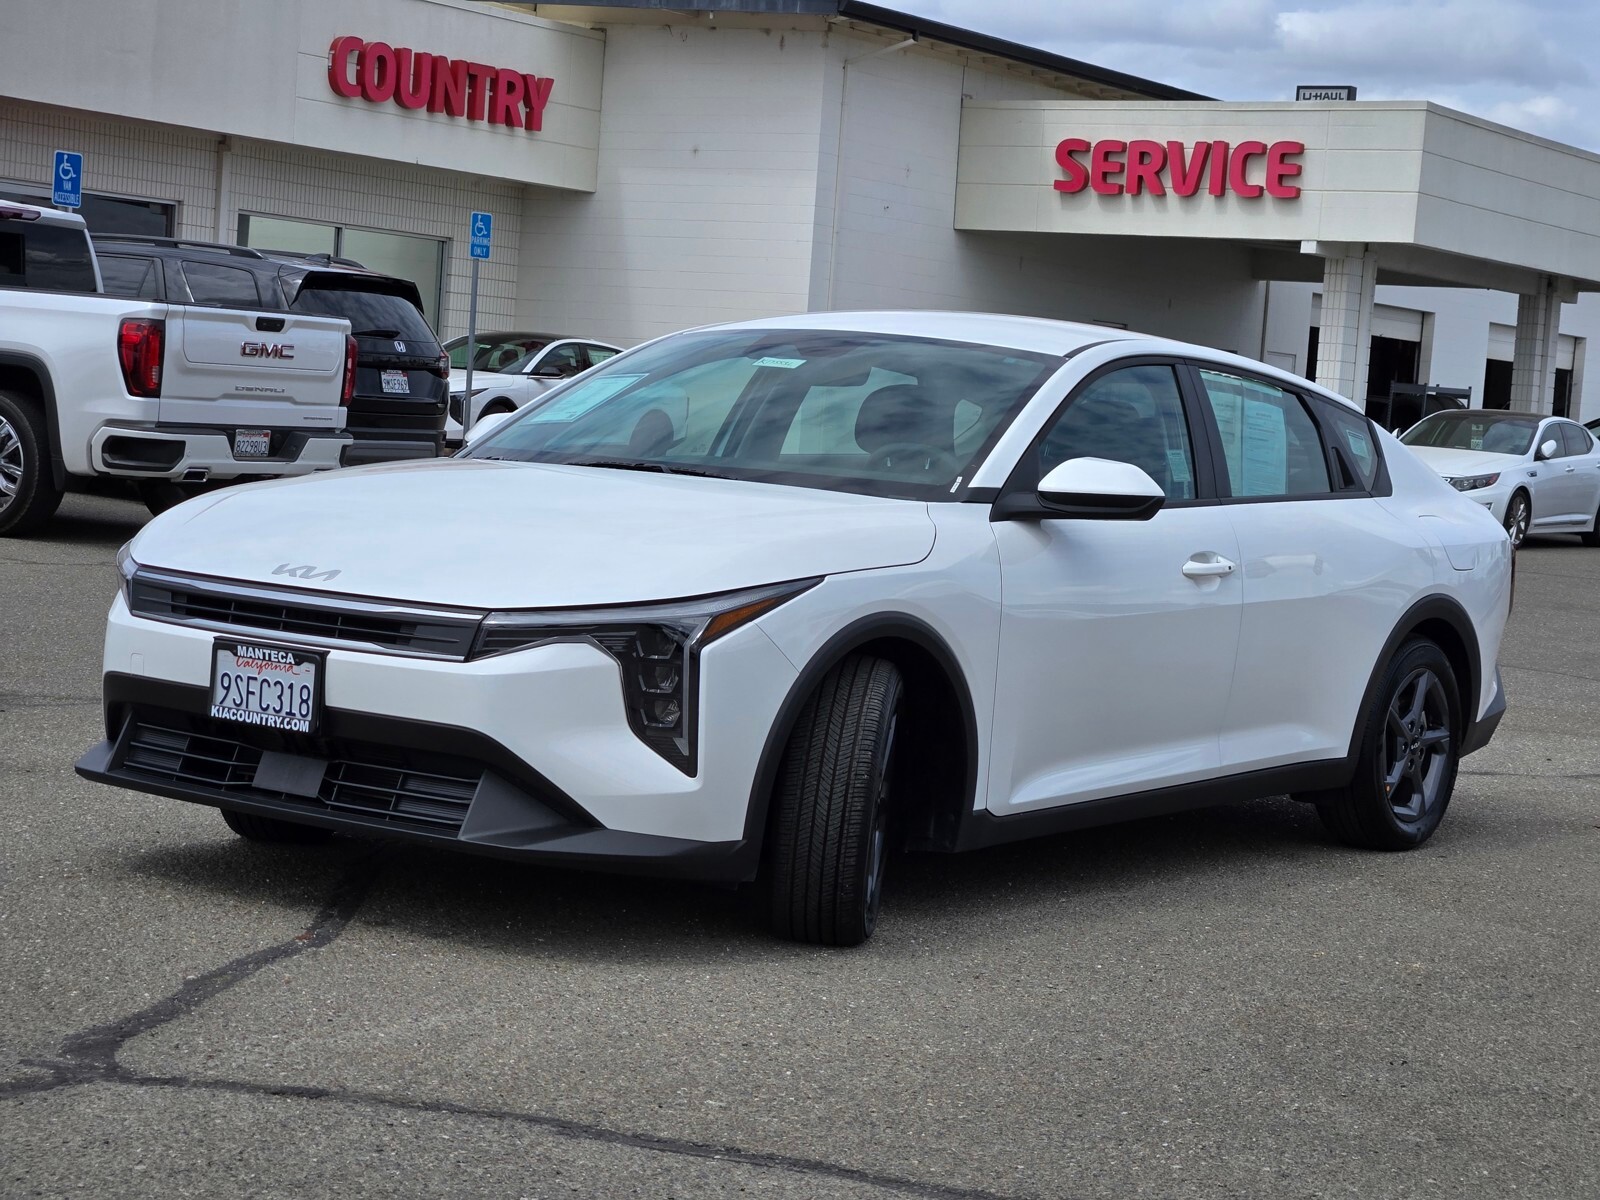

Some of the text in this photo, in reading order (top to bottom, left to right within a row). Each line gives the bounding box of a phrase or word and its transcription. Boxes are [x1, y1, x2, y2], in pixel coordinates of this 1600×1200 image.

[328, 35, 555, 132] COUNTRY
[1302, 92, 1345, 101] U-HAUL
[1053, 138, 1305, 200] SERVICE
[63, 181, 72, 191] VAN
[54, 192, 80, 205] ACCESSIBLE
[471, 236, 490, 247] PARKING
[473, 247, 487, 256] ONLY
[240, 341, 295, 361] GMC
[234, 385, 286, 394] DENALI
[271, 563, 342, 582] KIA
[236, 645, 295, 665] MANTECA
[235, 656, 300, 676] California
[218, 671, 311, 719] 9SFC318
[210, 705, 310, 733] KIACOUNTRY.COM
